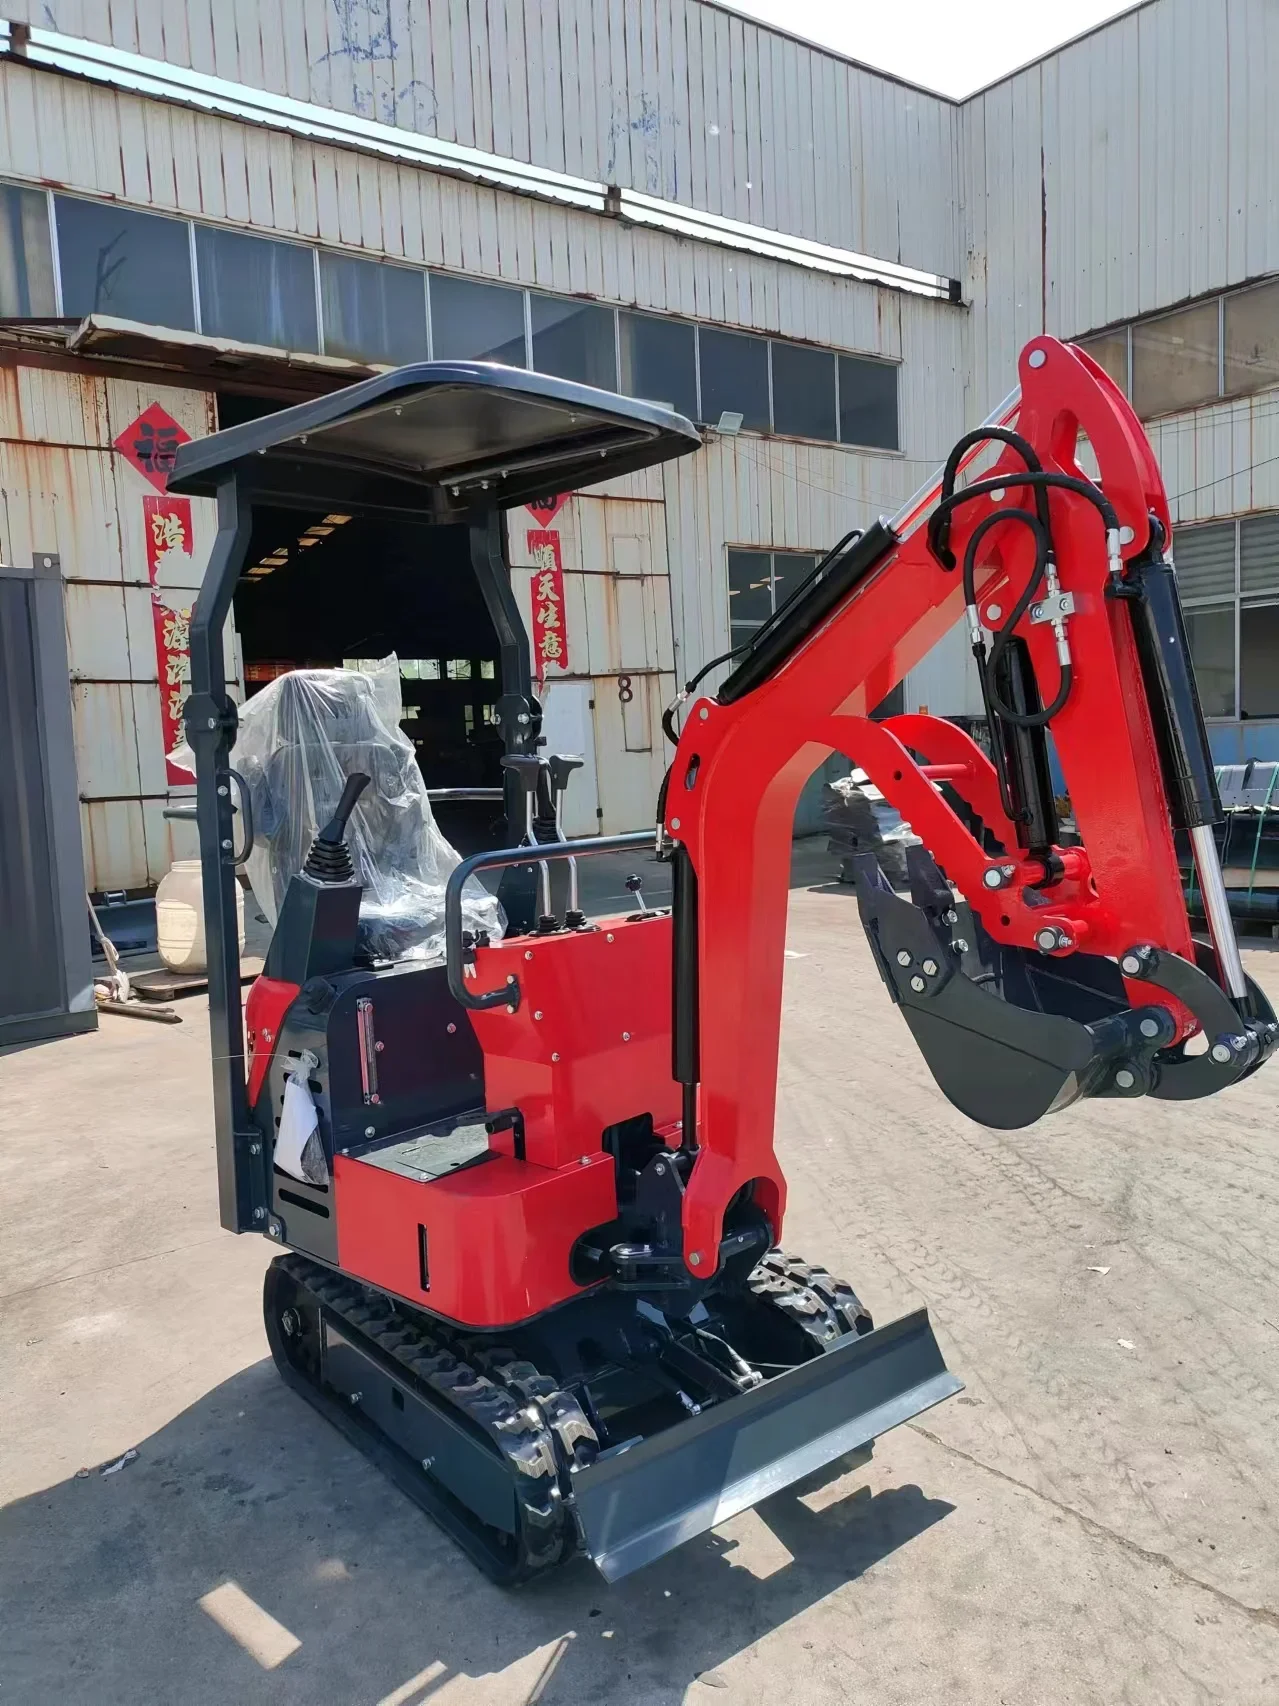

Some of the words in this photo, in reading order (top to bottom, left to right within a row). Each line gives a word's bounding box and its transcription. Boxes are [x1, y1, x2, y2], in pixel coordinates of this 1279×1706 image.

[133, 421, 179, 473] 福
[535, 543, 562, 682] 順天生意
[618, 676, 633, 703] 8
